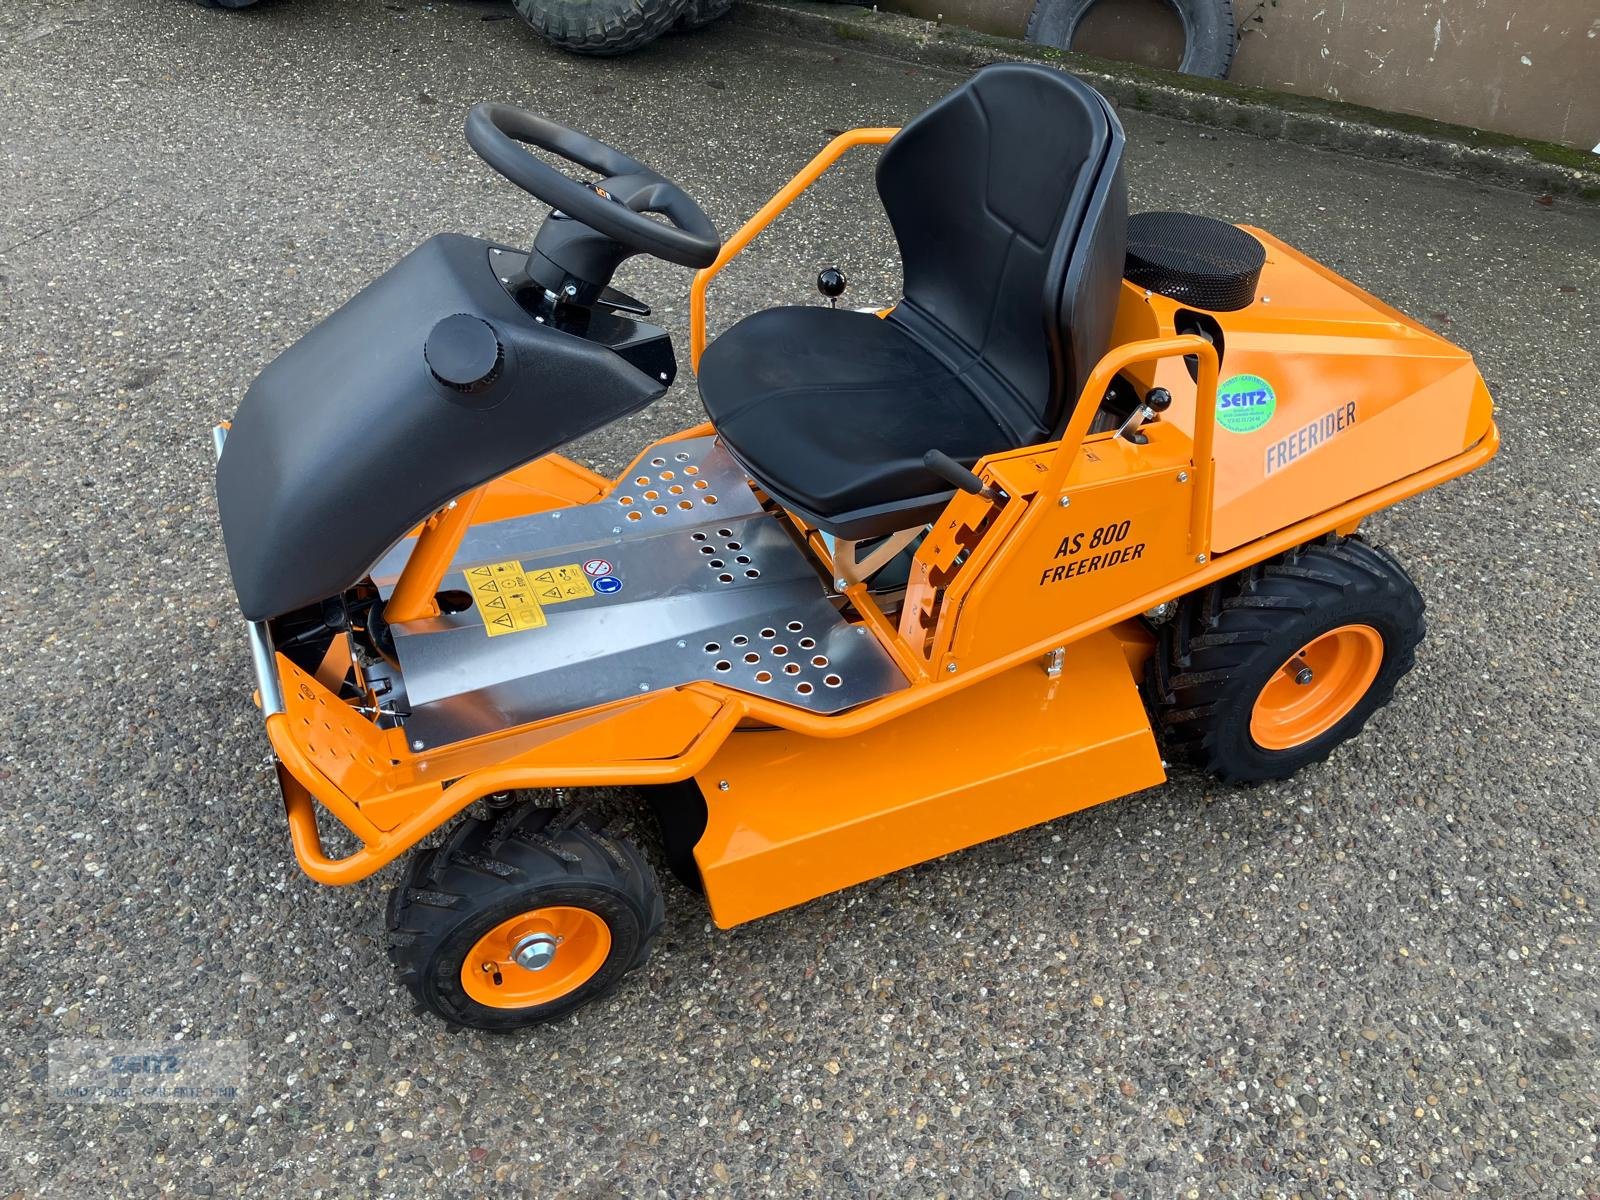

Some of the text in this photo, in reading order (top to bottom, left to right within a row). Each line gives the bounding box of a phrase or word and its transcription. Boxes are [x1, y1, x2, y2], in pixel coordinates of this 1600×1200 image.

[1221, 388, 1267, 408] SEITZ
[1266, 401, 1357, 474] FREERIDER
[1054, 520, 1131, 559] AS 800
[1040, 543, 1146, 586] FREERIDER
